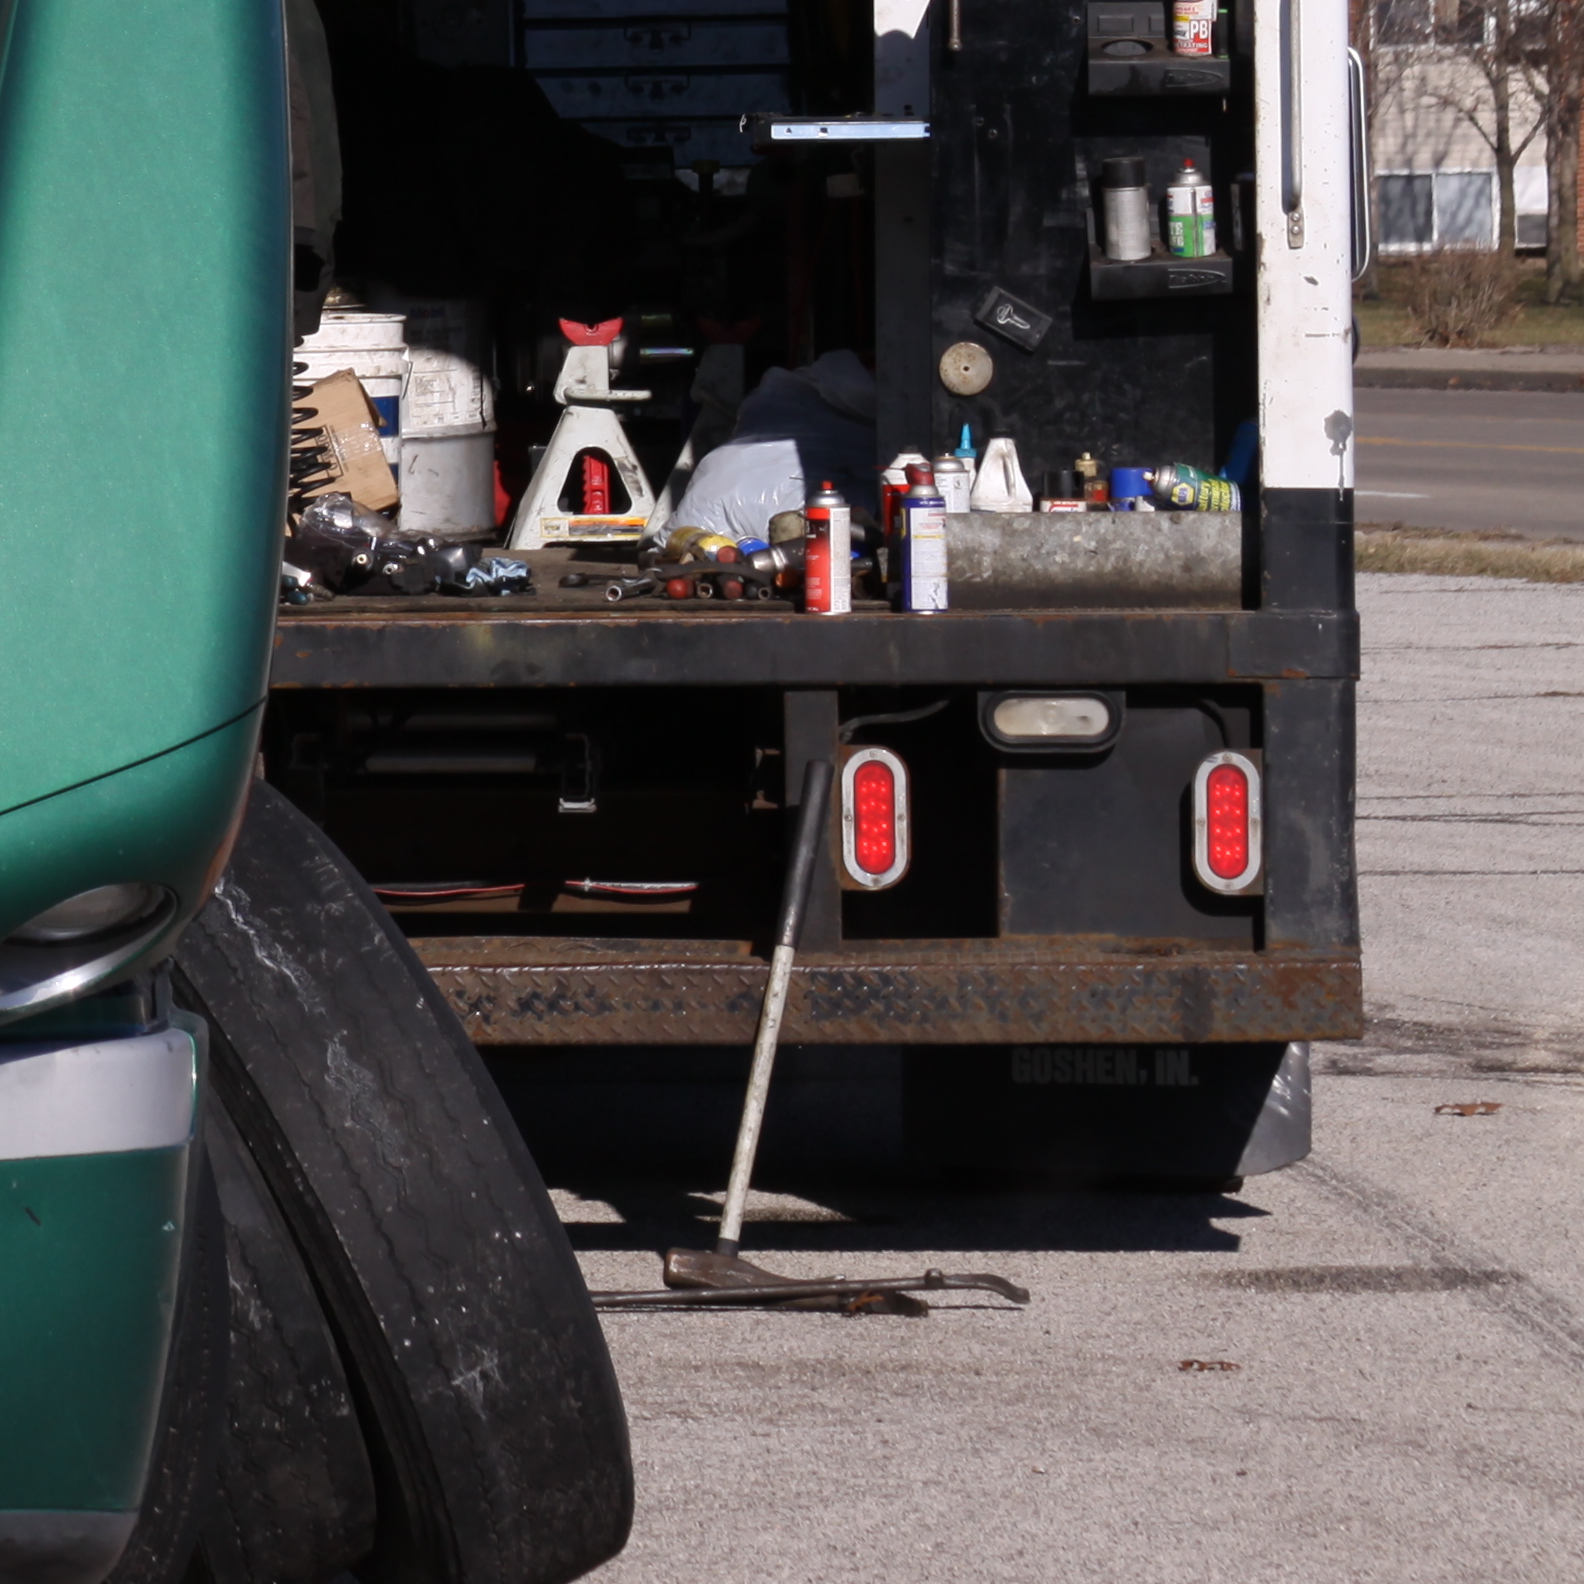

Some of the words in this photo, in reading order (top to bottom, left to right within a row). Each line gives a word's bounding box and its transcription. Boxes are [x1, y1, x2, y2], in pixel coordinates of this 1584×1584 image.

[410, 306, 445, 319] Mobil
[1011, 1046, 1148, 1085] GOSHEN,
[1154, 1048, 1199, 1086] IN.
